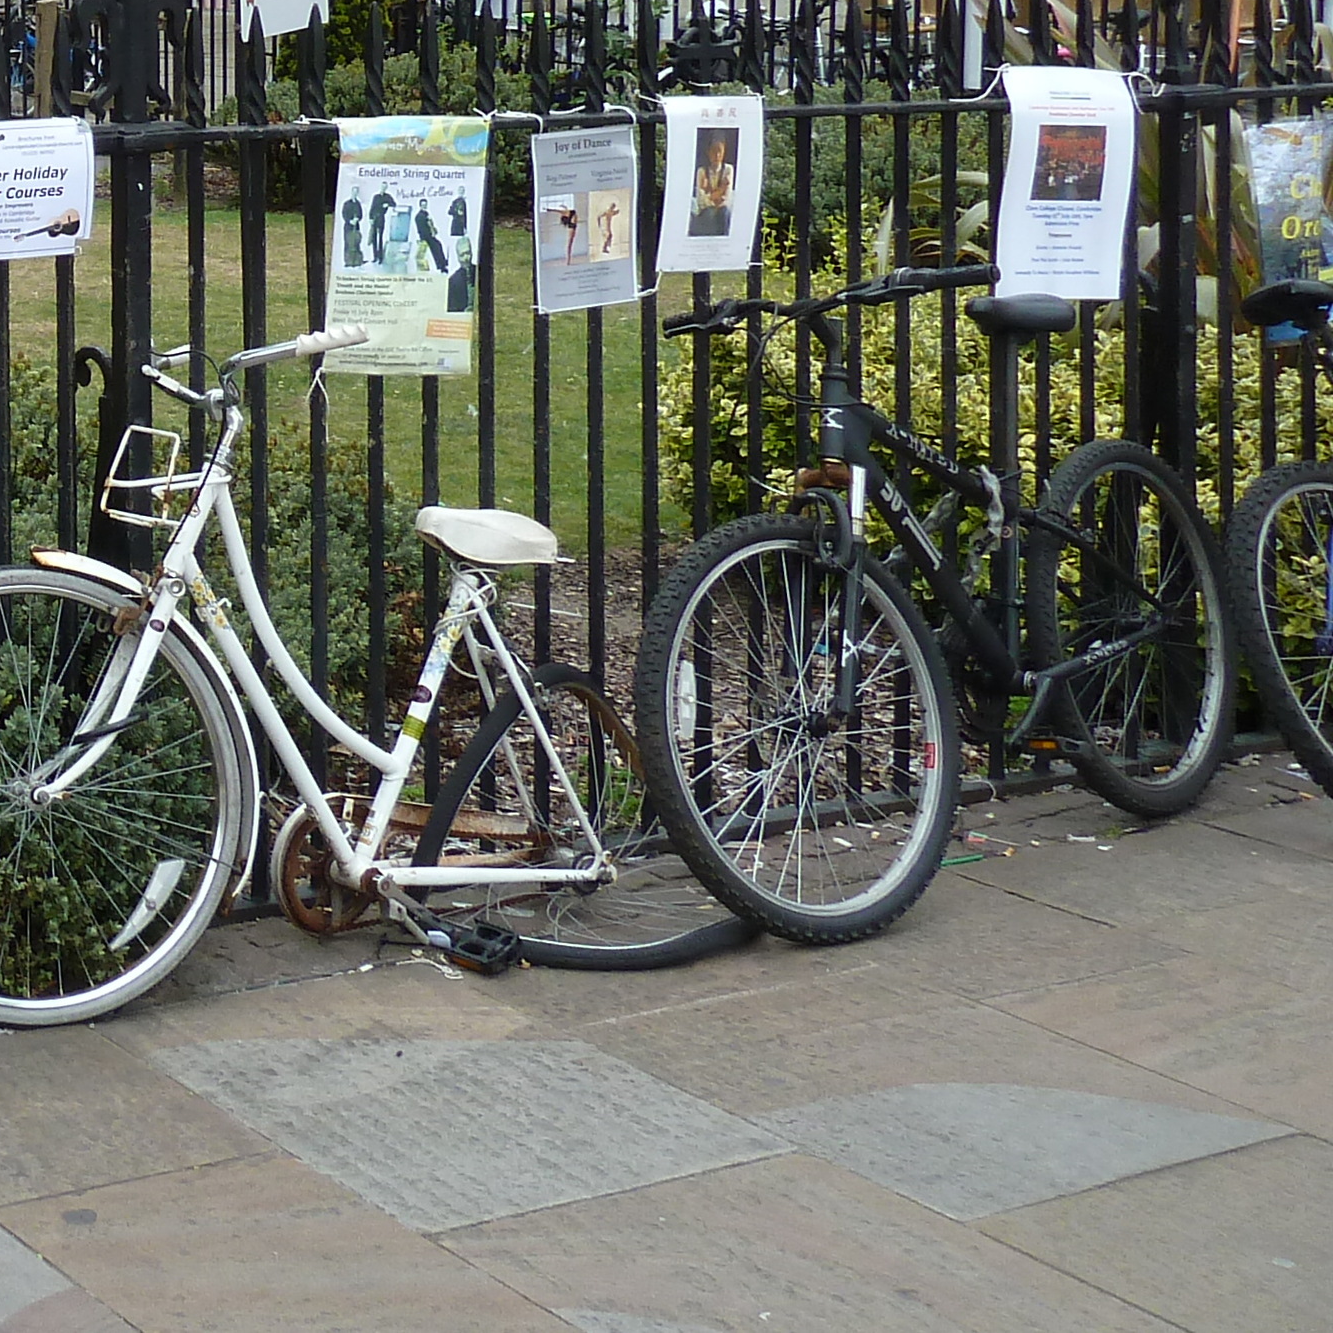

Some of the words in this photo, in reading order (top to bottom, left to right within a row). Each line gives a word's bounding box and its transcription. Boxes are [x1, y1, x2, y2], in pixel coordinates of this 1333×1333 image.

[554, 141, 570, 154] Joy
[583, 138, 612, 150] Dance
[13, 166, 68, 182] Holiday
[358, 167, 400, 178] Endellion
[402, 167, 430, 180] String
[432, 169, 466, 180] Quartet
[6, 185, 64, 200] Courses
